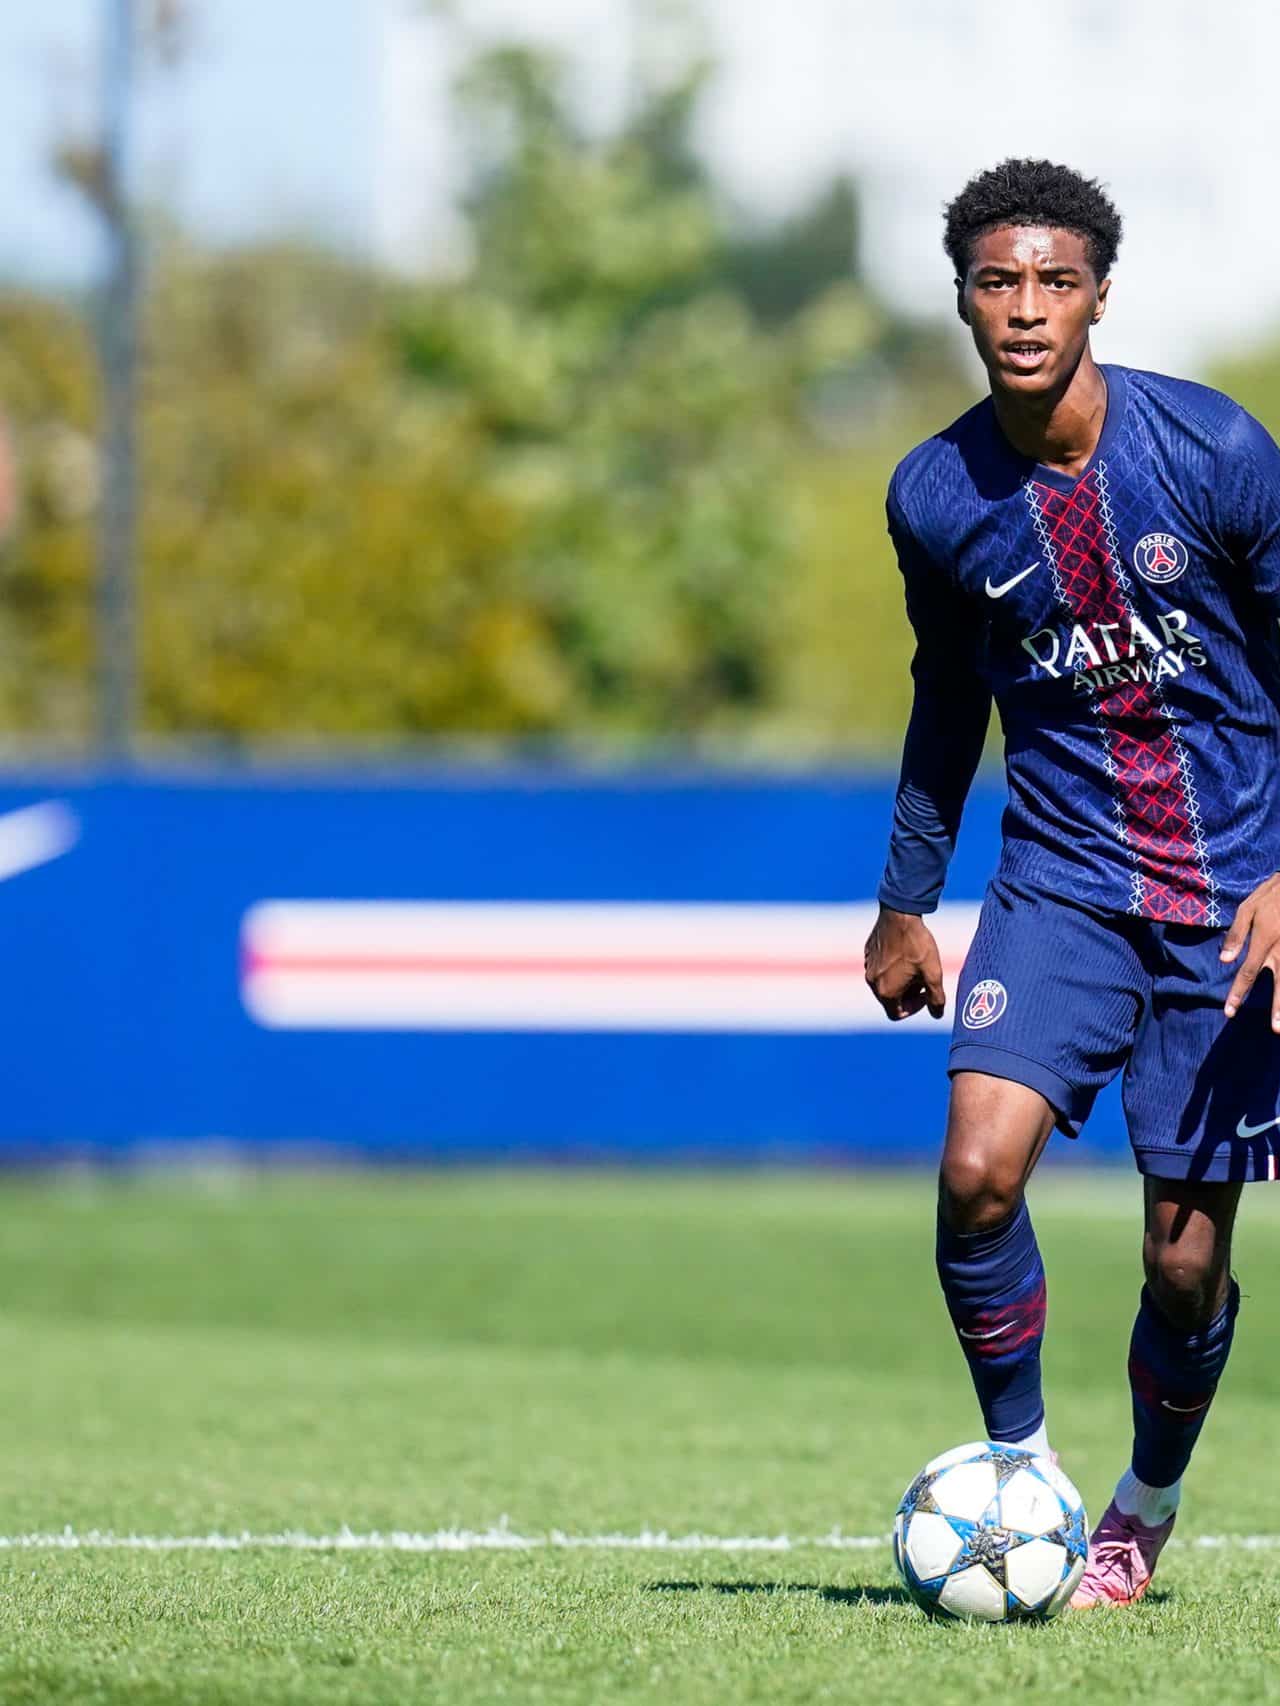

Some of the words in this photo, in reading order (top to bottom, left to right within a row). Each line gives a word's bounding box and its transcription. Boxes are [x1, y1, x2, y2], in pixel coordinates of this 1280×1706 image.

[1140, 535, 1176, 550] PARIS
[1020, 609, 1201, 679] QATAR
[1072, 646, 1207, 690] AIRWAYS
